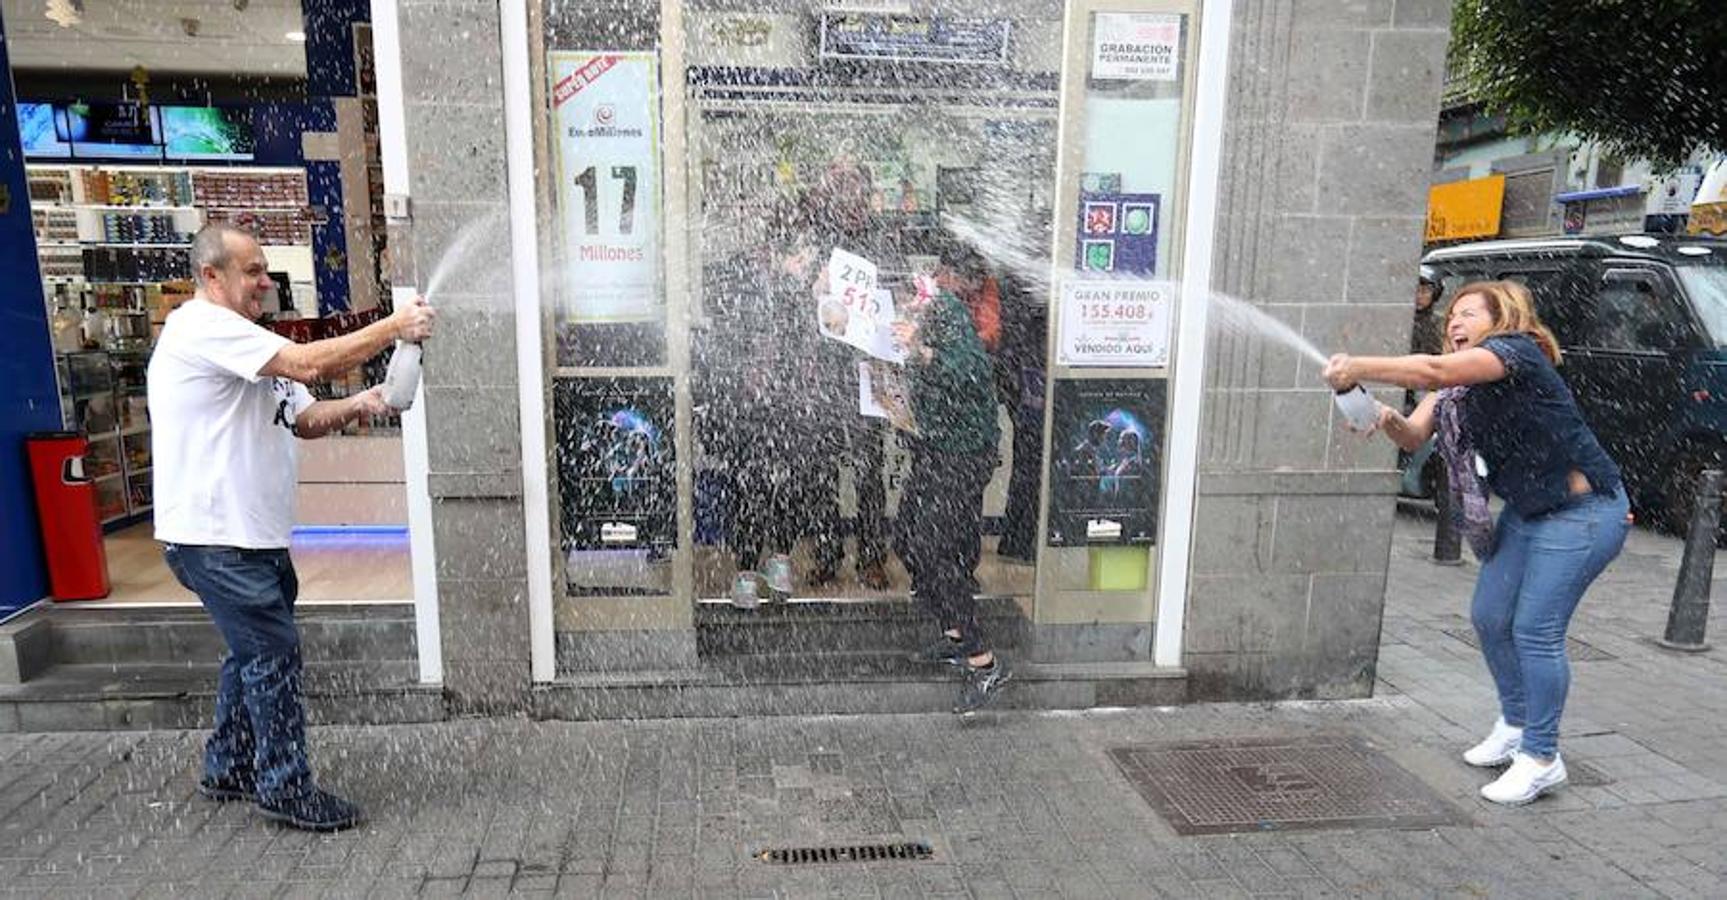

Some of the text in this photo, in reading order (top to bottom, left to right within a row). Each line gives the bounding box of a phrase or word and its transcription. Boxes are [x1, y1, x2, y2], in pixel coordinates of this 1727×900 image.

[1099, 54, 1170, 64] PERMANENTE
[574, 166, 638, 235] 17
[580, 245, 644, 261] Millones
[839, 264, 853, 282] 2
[1074, 290, 1160, 302] GRAN PREMIO
[1074, 342, 1122, 354] VENDIDO
